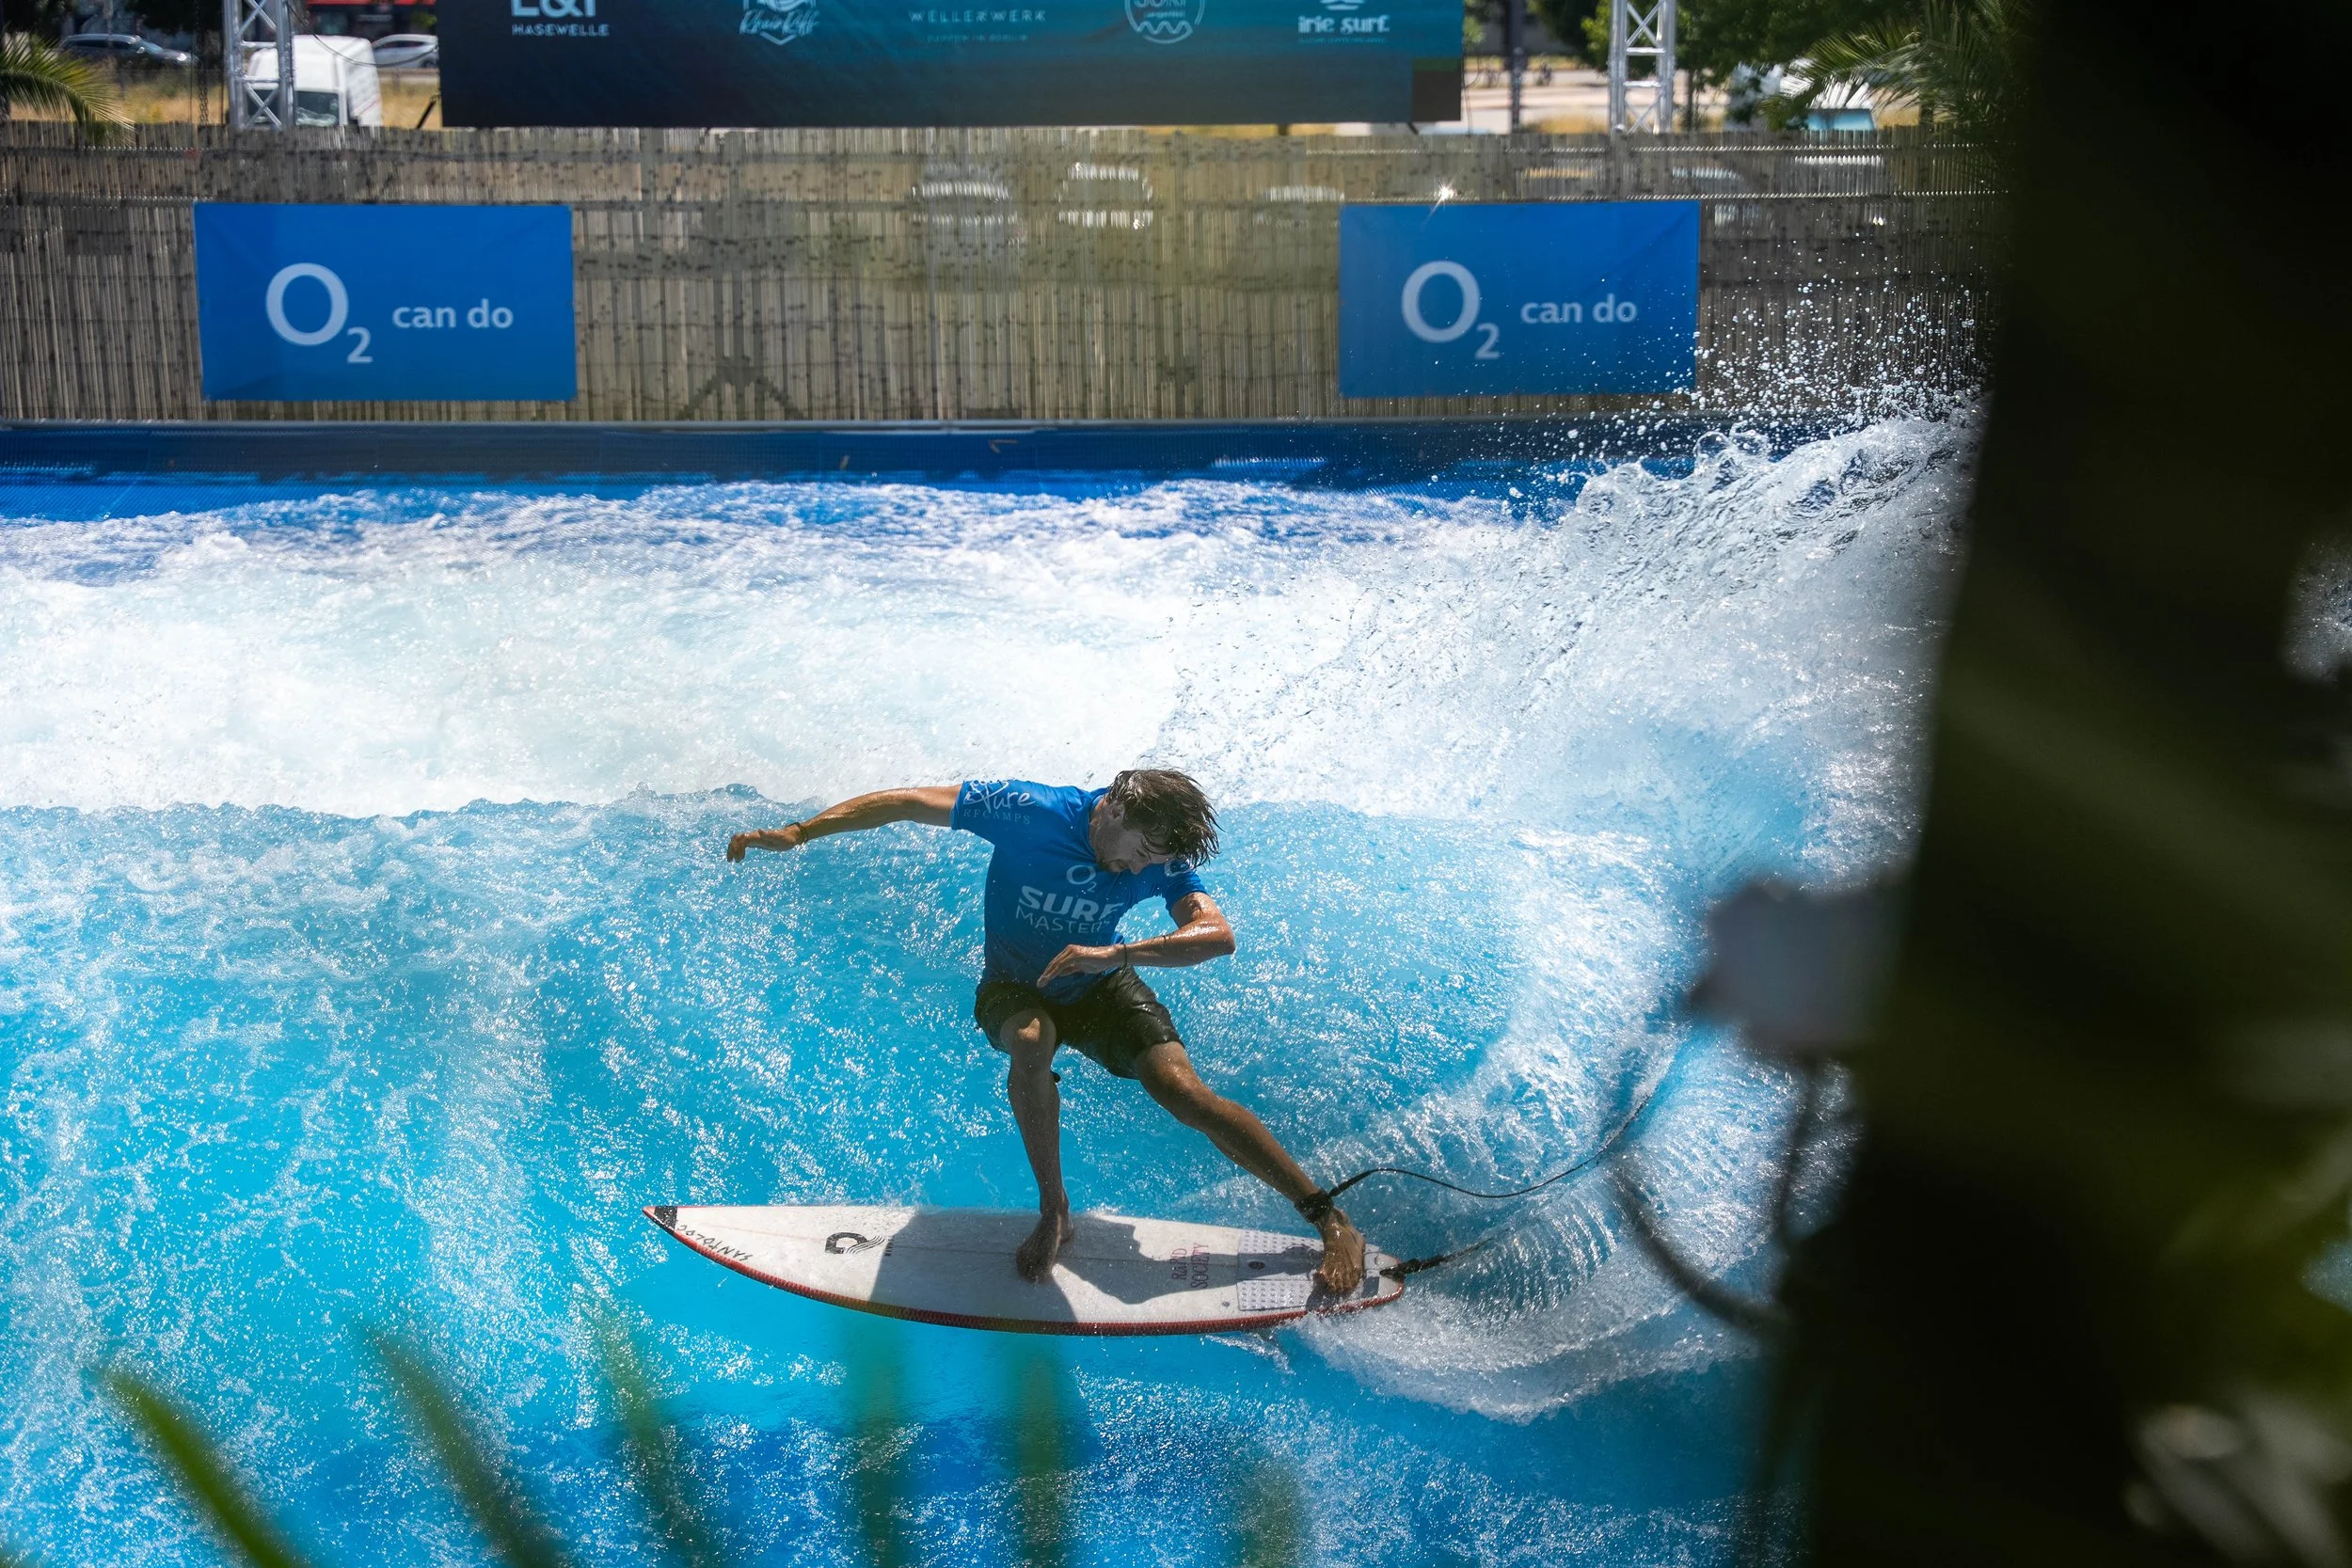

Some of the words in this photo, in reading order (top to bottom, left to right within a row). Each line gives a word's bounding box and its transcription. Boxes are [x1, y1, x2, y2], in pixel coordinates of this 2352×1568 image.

[511, 24, 610, 37] HASEWELLE
[391, 306, 457, 328] can
[467, 298, 514, 328] do
[1520, 300, 1582, 324] can
[1593, 293, 1637, 323] do
[1018, 885, 1124, 922] SURF
[1190, 1243, 1210, 1289] SOCIETY
